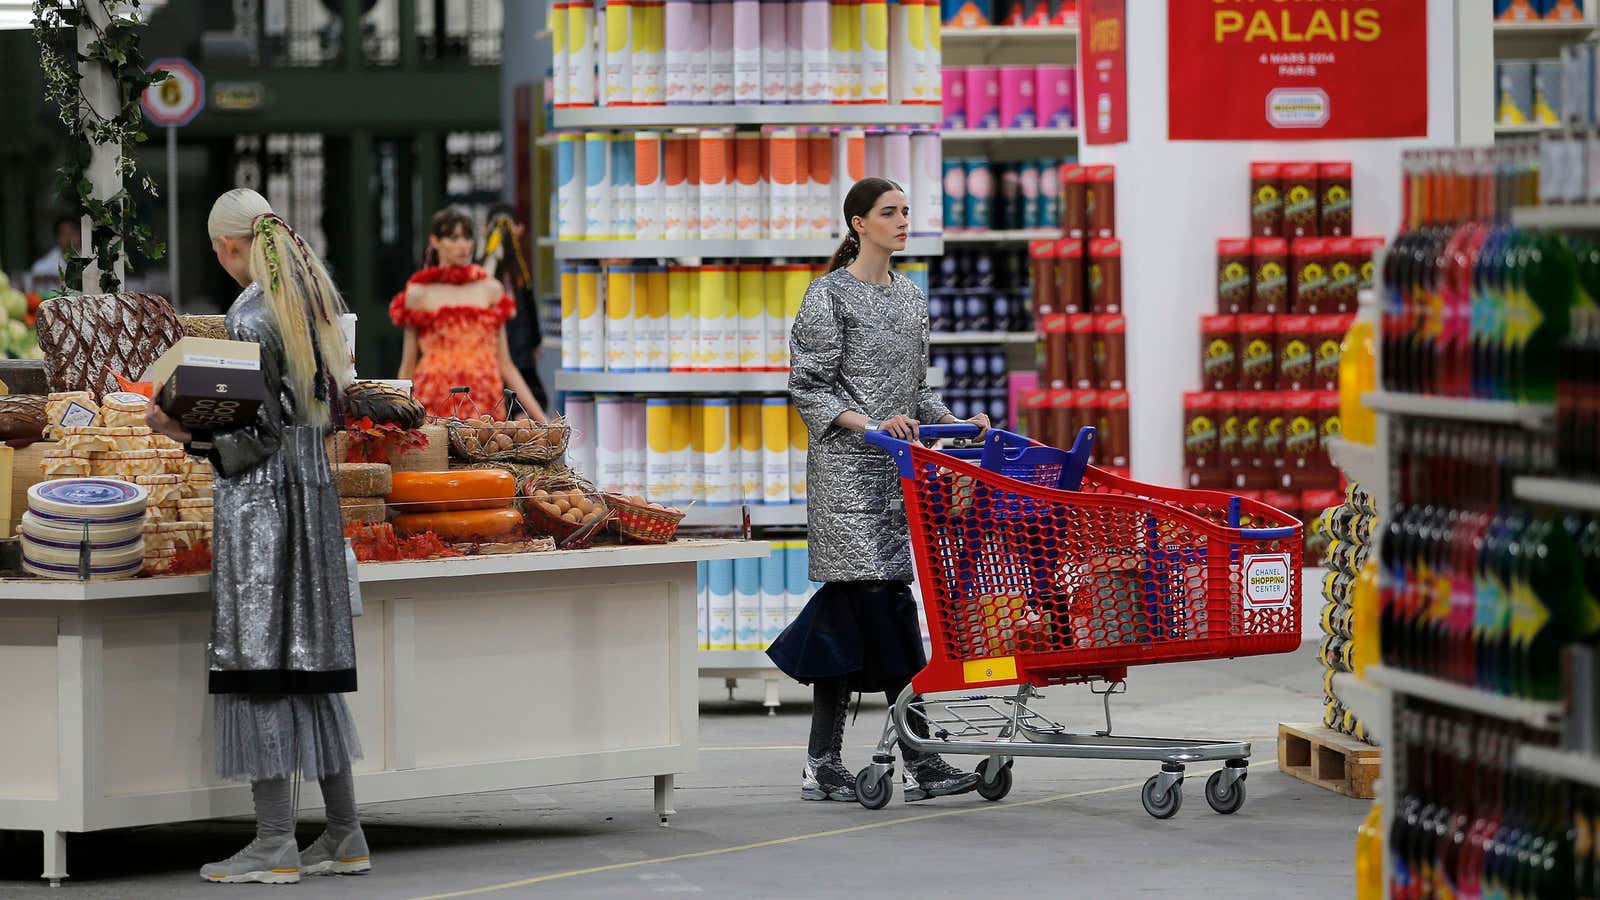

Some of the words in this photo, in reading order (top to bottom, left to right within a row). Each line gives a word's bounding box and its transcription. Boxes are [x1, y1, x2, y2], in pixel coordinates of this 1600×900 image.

[1214, 8, 1382, 43] PALAIS
[1270, 53, 1306, 64] MARS
[1279, 65, 1316, 76] PARIS
[1255, 568, 1280, 576] CHANEL
[1250, 576, 1285, 585] SHOPPING
[1255, 585, 1281, 593] CENTER
